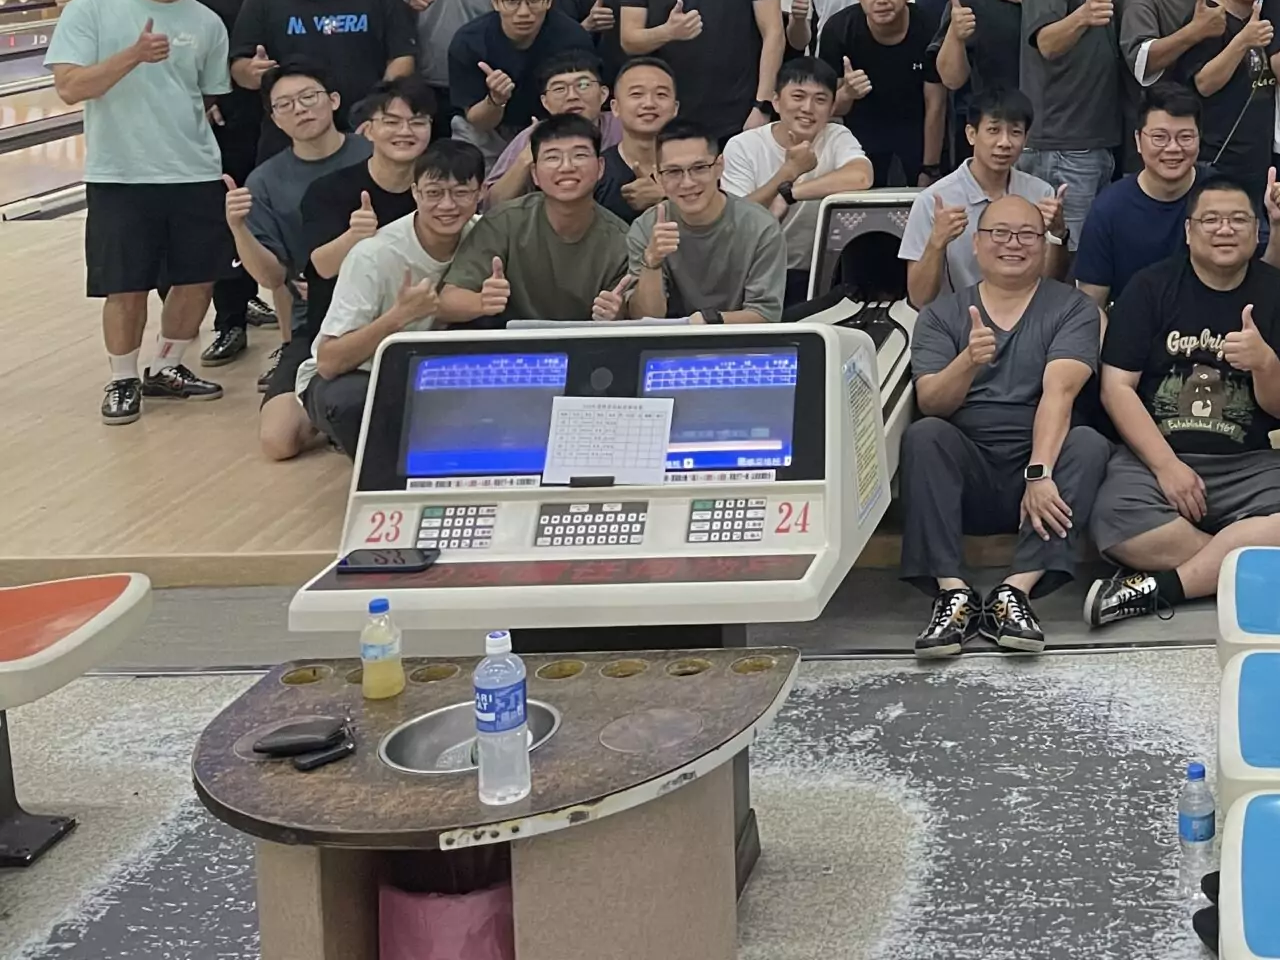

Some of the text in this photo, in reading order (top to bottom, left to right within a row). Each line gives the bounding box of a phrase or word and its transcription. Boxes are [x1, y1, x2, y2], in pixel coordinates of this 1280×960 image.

[1166, 330, 1199, 357] Gap
[1168, 419, 1236, 434] Established 1969
[365, 511, 403, 543] 23
[774, 501, 811, 534] 24
